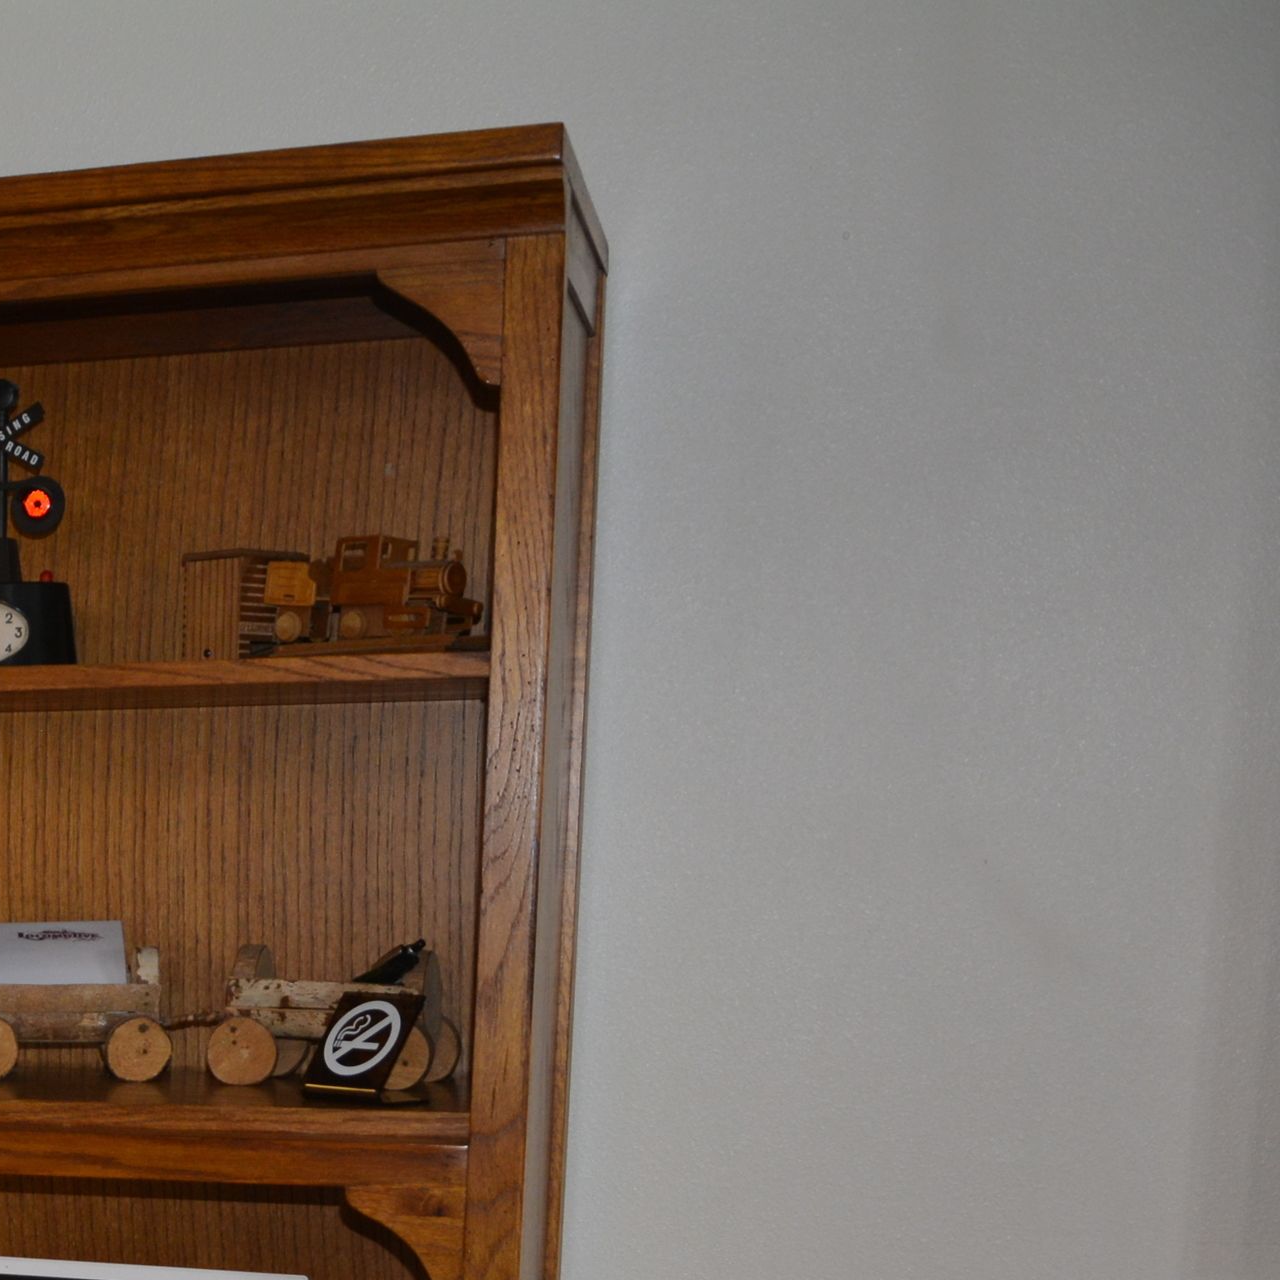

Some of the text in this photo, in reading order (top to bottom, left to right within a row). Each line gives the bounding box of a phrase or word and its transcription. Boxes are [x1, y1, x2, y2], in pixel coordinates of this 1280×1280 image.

[5, 441, 39, 465] ROAD
[5, 613, 13, 624] 2
[15, 627, 22, 638] 3
[5, 644, 12, 653] 4
